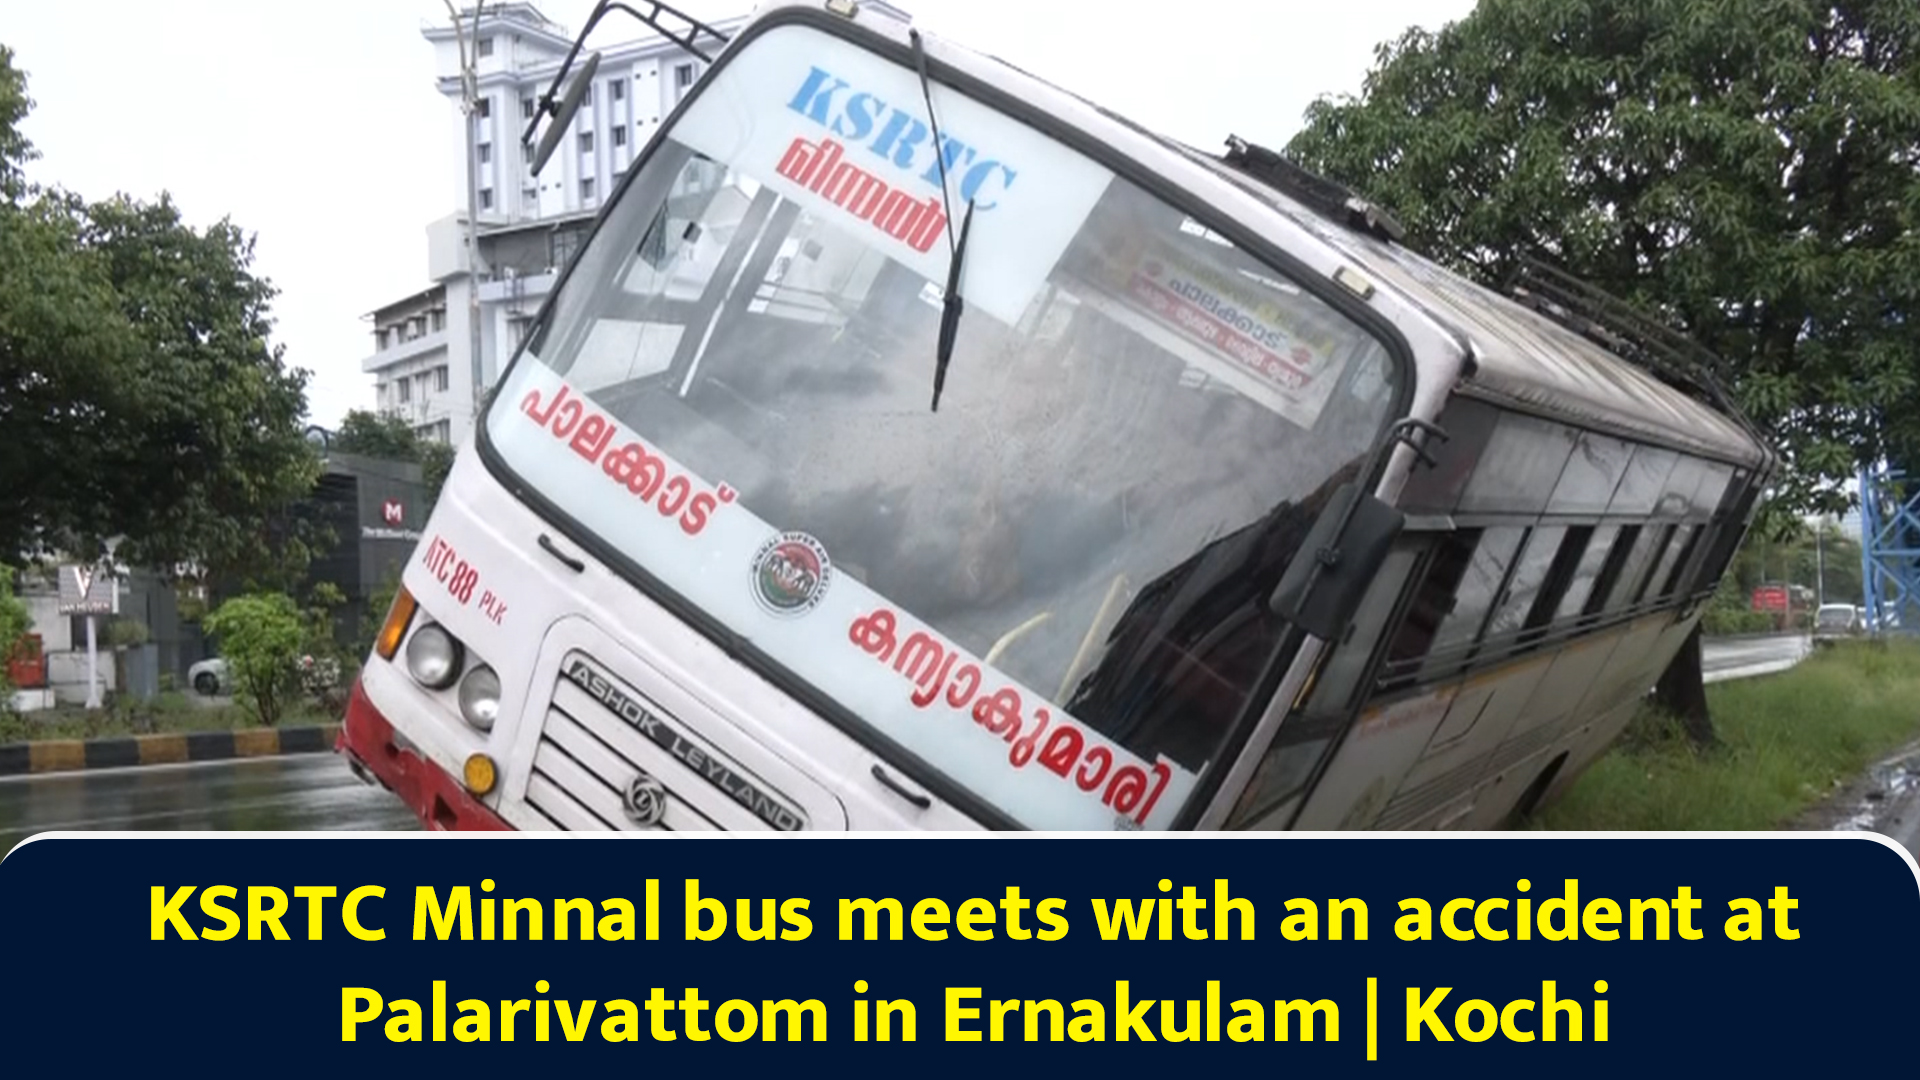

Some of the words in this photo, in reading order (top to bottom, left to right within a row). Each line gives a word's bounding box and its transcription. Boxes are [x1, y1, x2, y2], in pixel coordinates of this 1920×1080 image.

[786, 66, 1017, 211] KSRTC
[385, 501, 402, 521] M
[520, 383, 738, 536] പാലക്കാട്
[478, 590, 507, 625] PLK
[783, 532, 816, 547] SUPER
[572, 666, 662, 736] ASHOK
[671, 737, 799, 831] LEYLAND
[849, 609, 1172, 825] കന്യാകുമാരി
